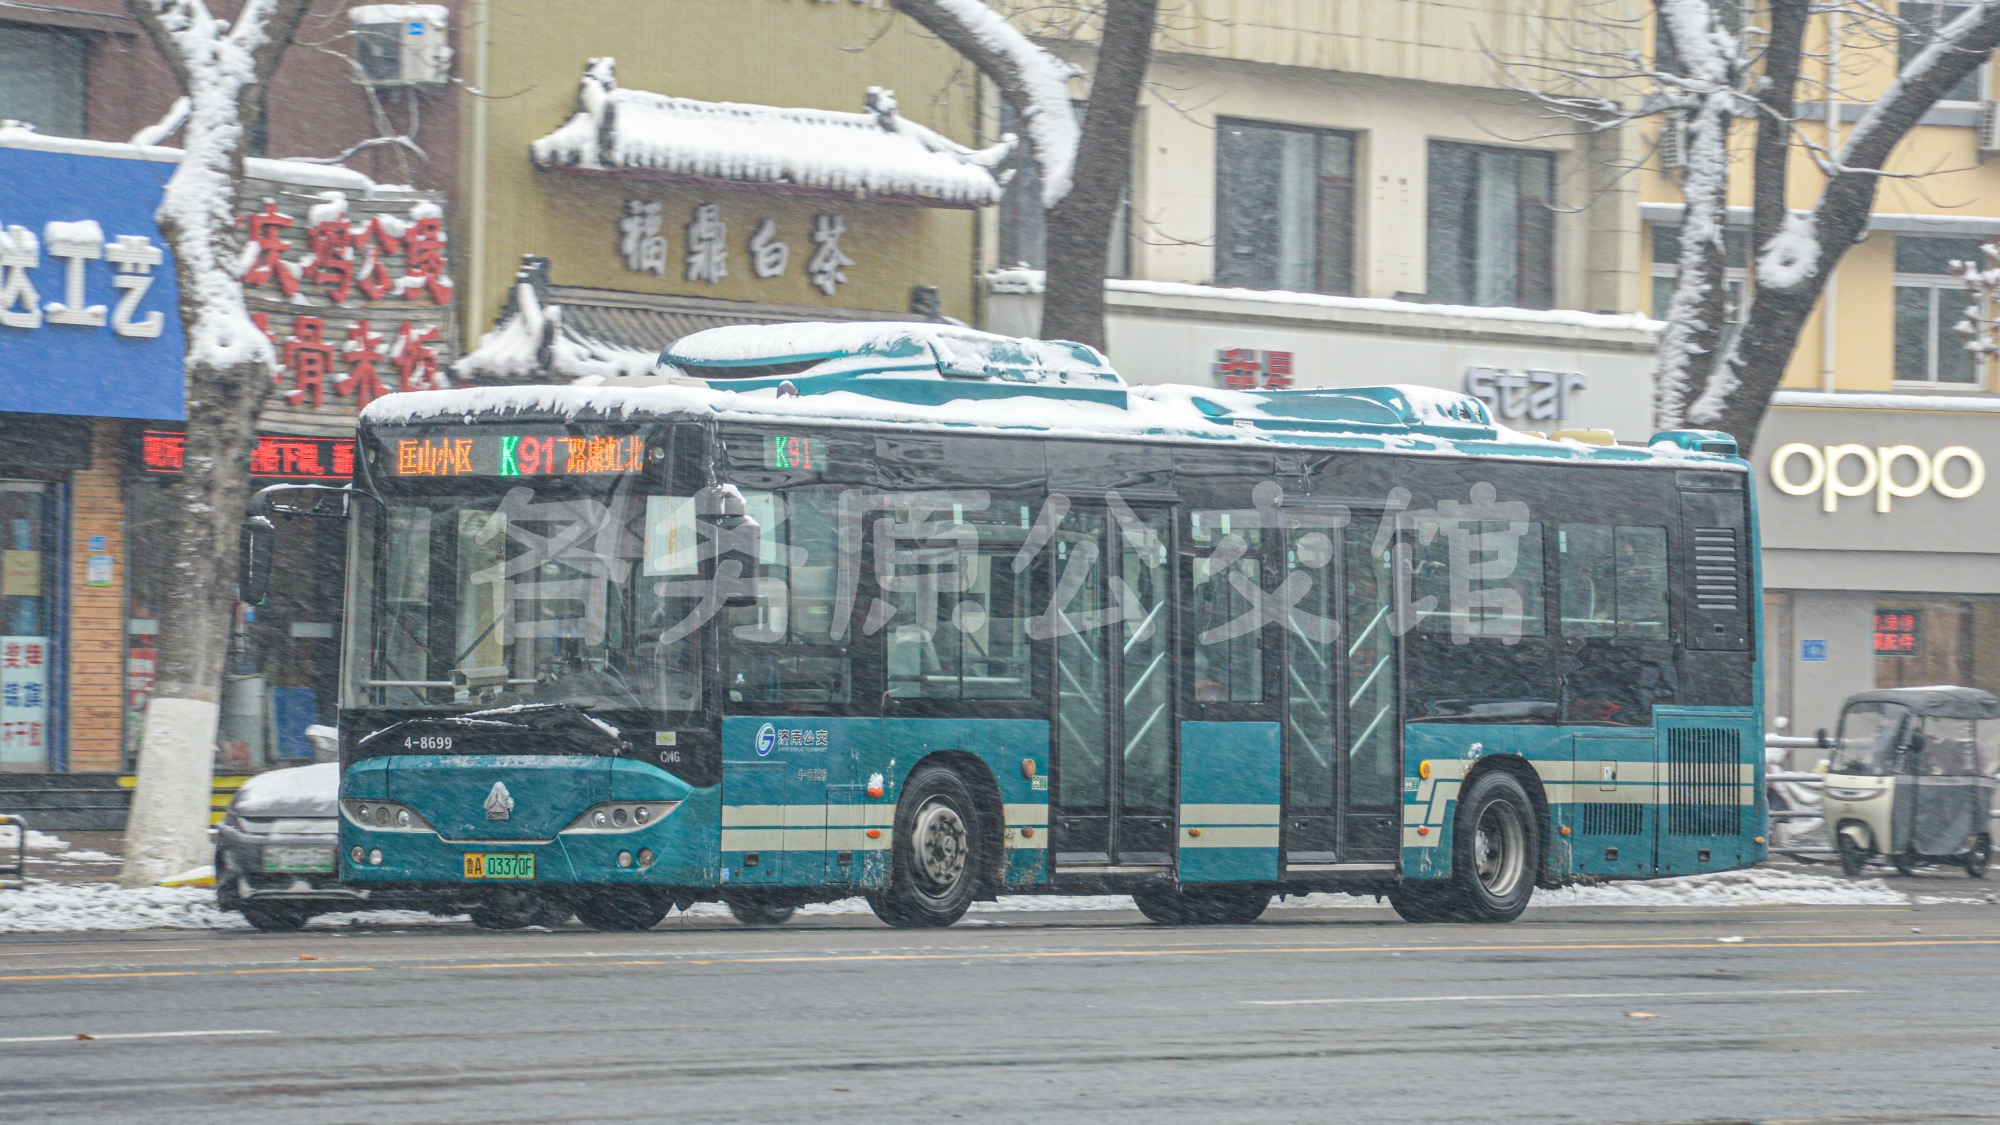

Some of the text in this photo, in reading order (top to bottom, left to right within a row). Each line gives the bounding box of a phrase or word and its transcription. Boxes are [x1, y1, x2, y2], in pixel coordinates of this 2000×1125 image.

[235, 205, 454, 306] 庆鸡公煲
[620, 201, 855, 296] 福鼎白茶
[0, 221, 163, 338] 达工艺
[1466, 366, 1587, 420] star
[399, 438, 473, 475] 匡山小区
[501, 436, 554, 476] K91
[775, 436, 812, 469] K91
[1770, 443, 1985, 513] oppo
[404, 736, 453, 750] 4-8699
[660, 750, 680, 763] CNG
[777, 729, 828, 746] 济南公交
